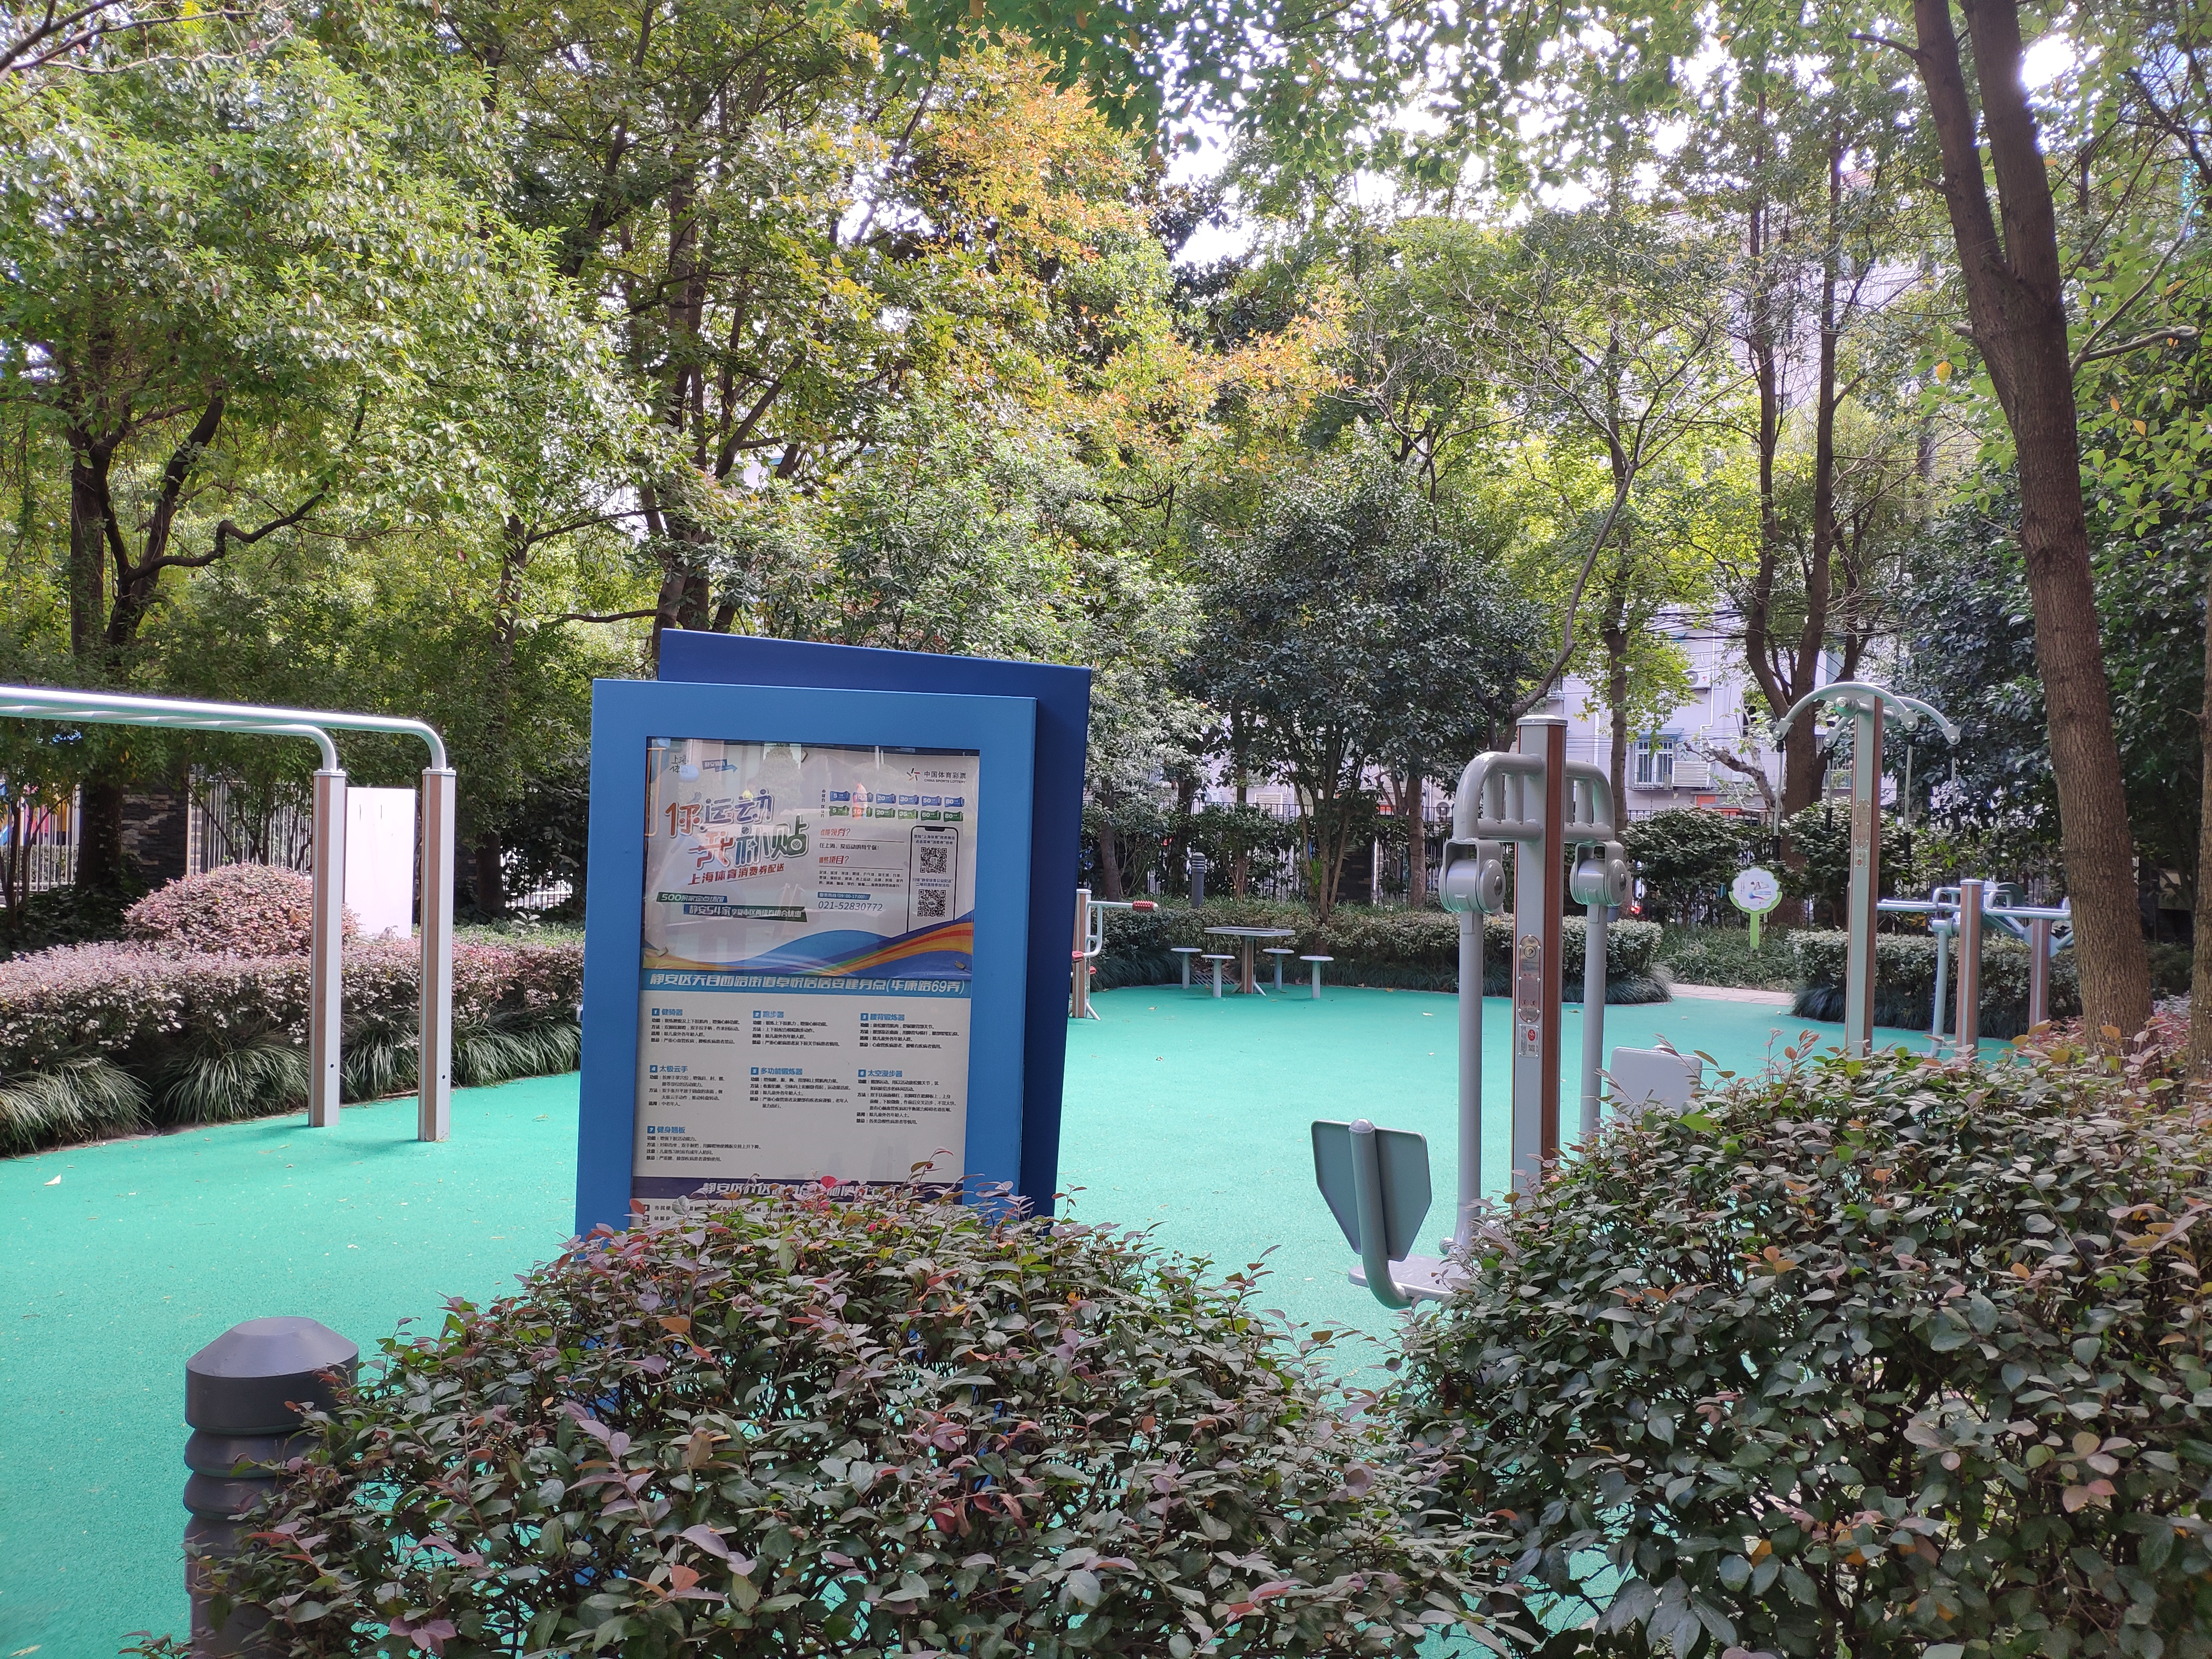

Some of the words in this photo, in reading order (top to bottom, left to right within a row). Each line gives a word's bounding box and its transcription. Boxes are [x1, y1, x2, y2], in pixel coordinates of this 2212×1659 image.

[924, 771, 967, 780] 中国体育彩票
[665, 789, 774, 837] 你运动
[688, 814, 809, 869] 我补贴
[687, 862, 785, 885] 上海体育消费券配送
[661, 894, 725, 903] 500余家定点场馆
[818, 901, 883, 911] 021-52830772
